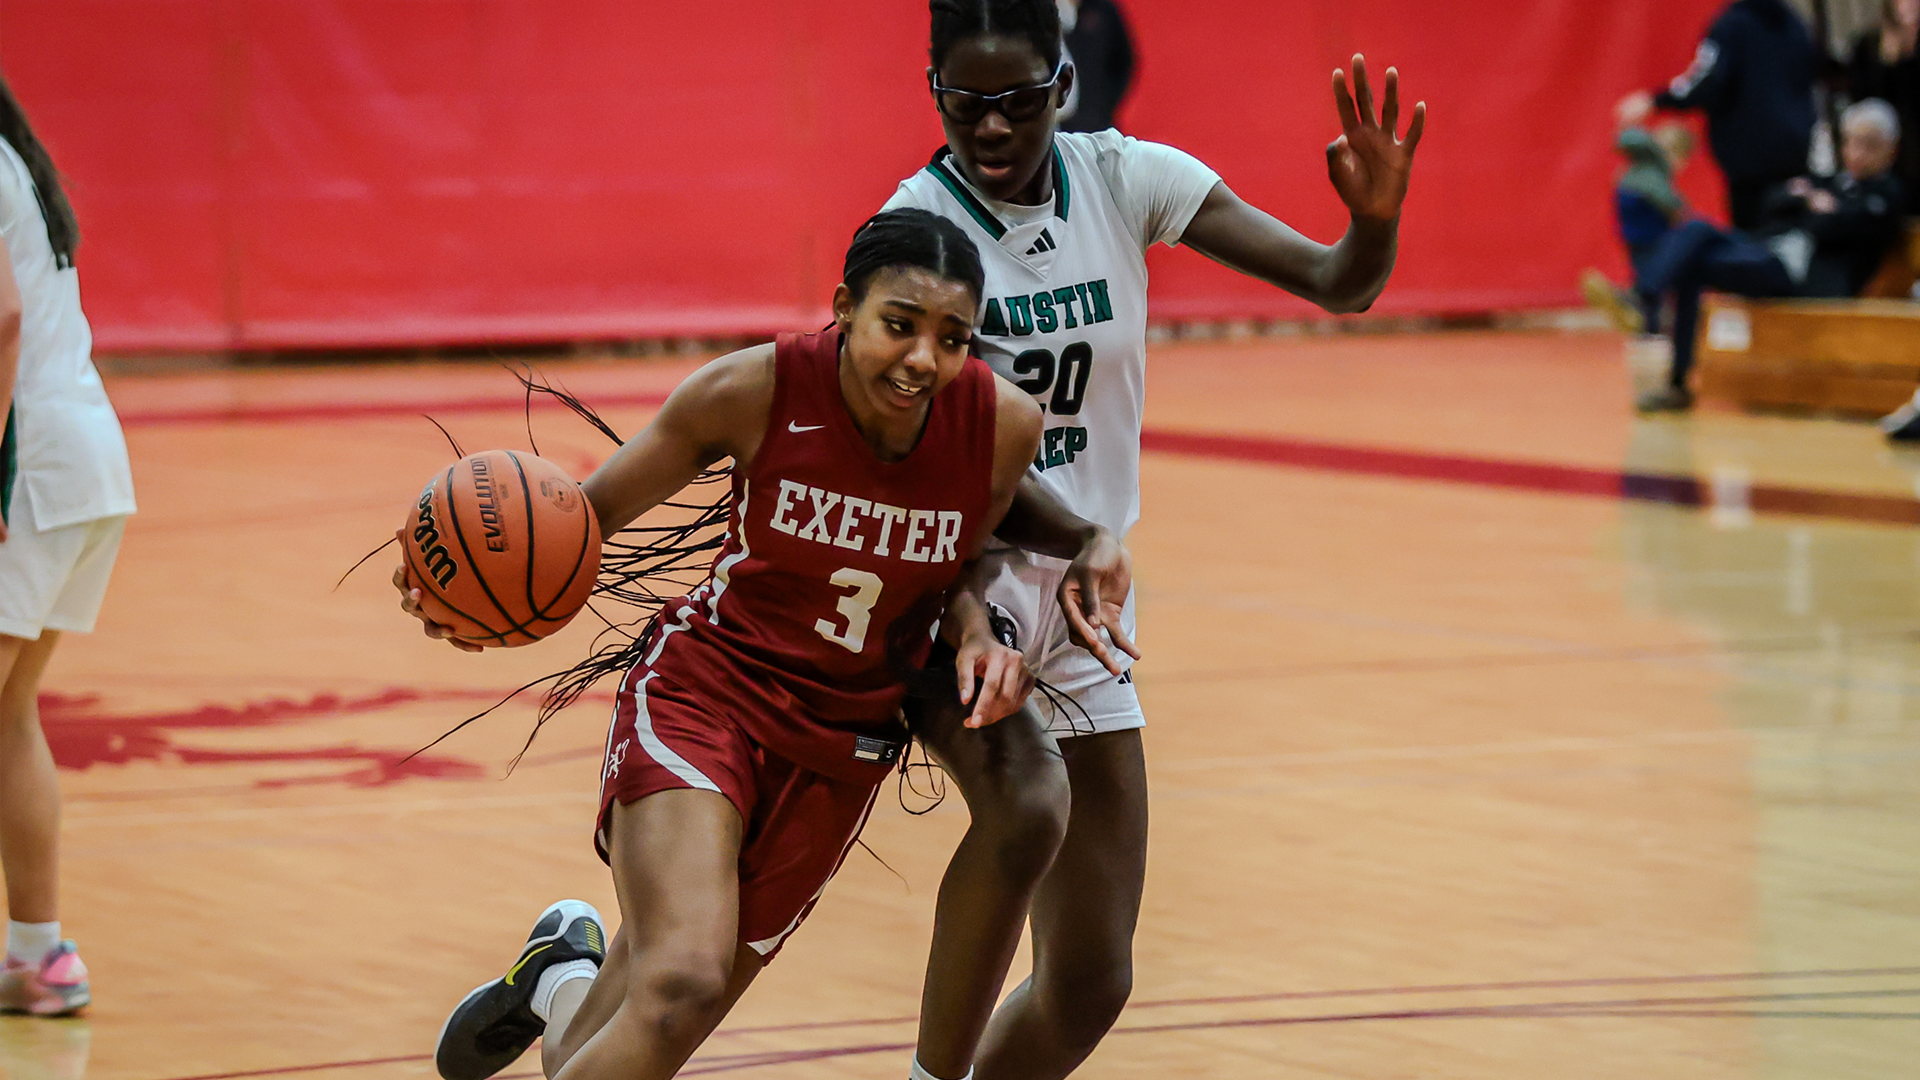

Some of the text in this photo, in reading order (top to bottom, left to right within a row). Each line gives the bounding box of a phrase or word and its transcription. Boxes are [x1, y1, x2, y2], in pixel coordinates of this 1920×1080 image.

[981, 279, 1113, 336] AUSTIN
[1013, 341, 1093, 415] 20
[1033, 426, 1088, 473] EP
[470, 458, 504, 552] EVOLUTION
[770, 479, 962, 562] EXETER
[814, 567, 884, 653] 3
[885, 749, 894, 758] S
